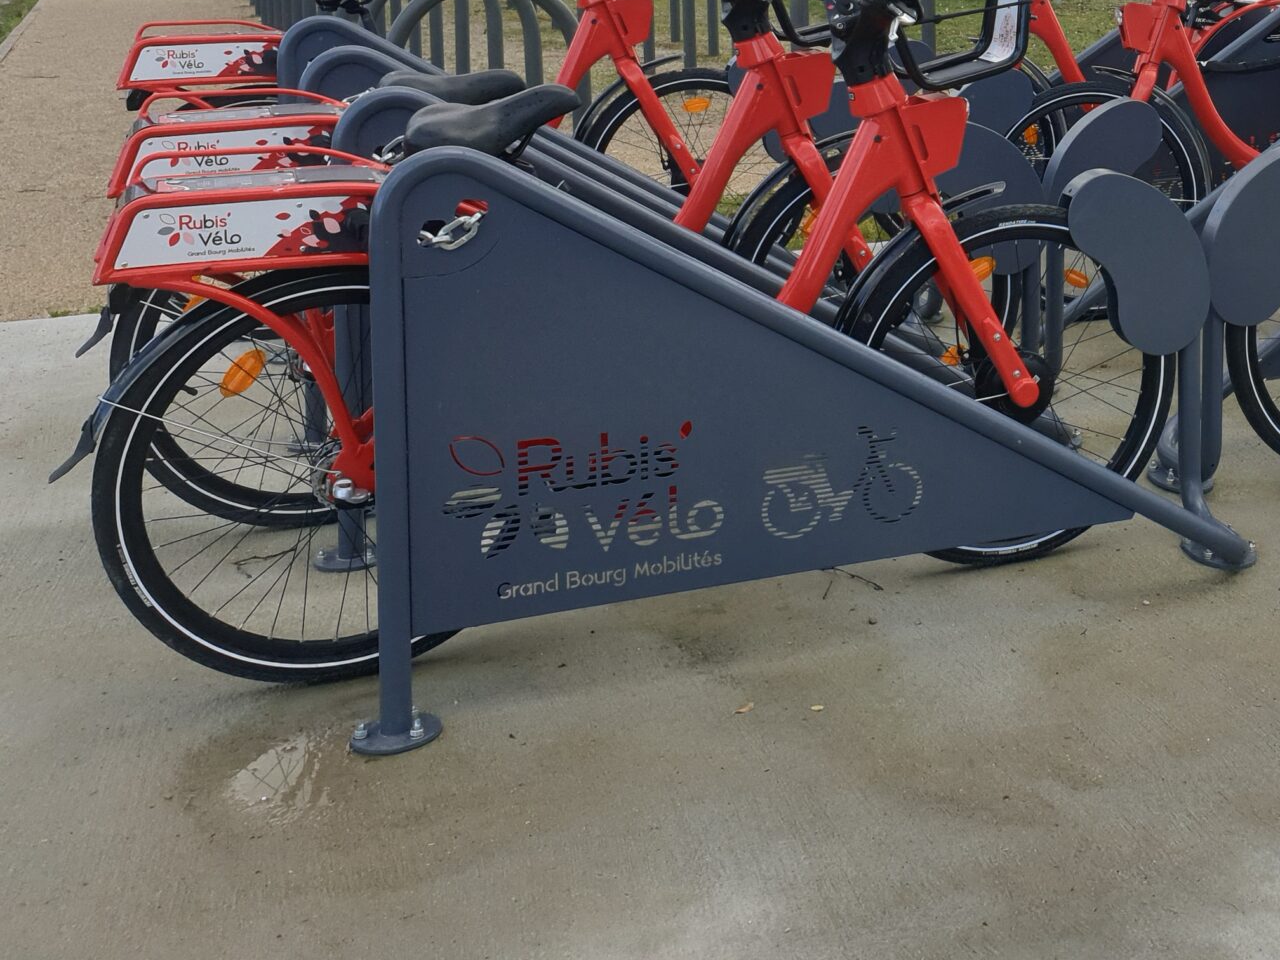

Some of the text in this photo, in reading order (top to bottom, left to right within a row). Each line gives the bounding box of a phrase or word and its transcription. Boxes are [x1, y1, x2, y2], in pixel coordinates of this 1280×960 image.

[178, 60, 204, 69] Vélo
[199, 229, 242, 247] Vélo
[583, 485, 724, 552] Vélo
[497, 550, 723, 601] Grand Bourg Mobilités
